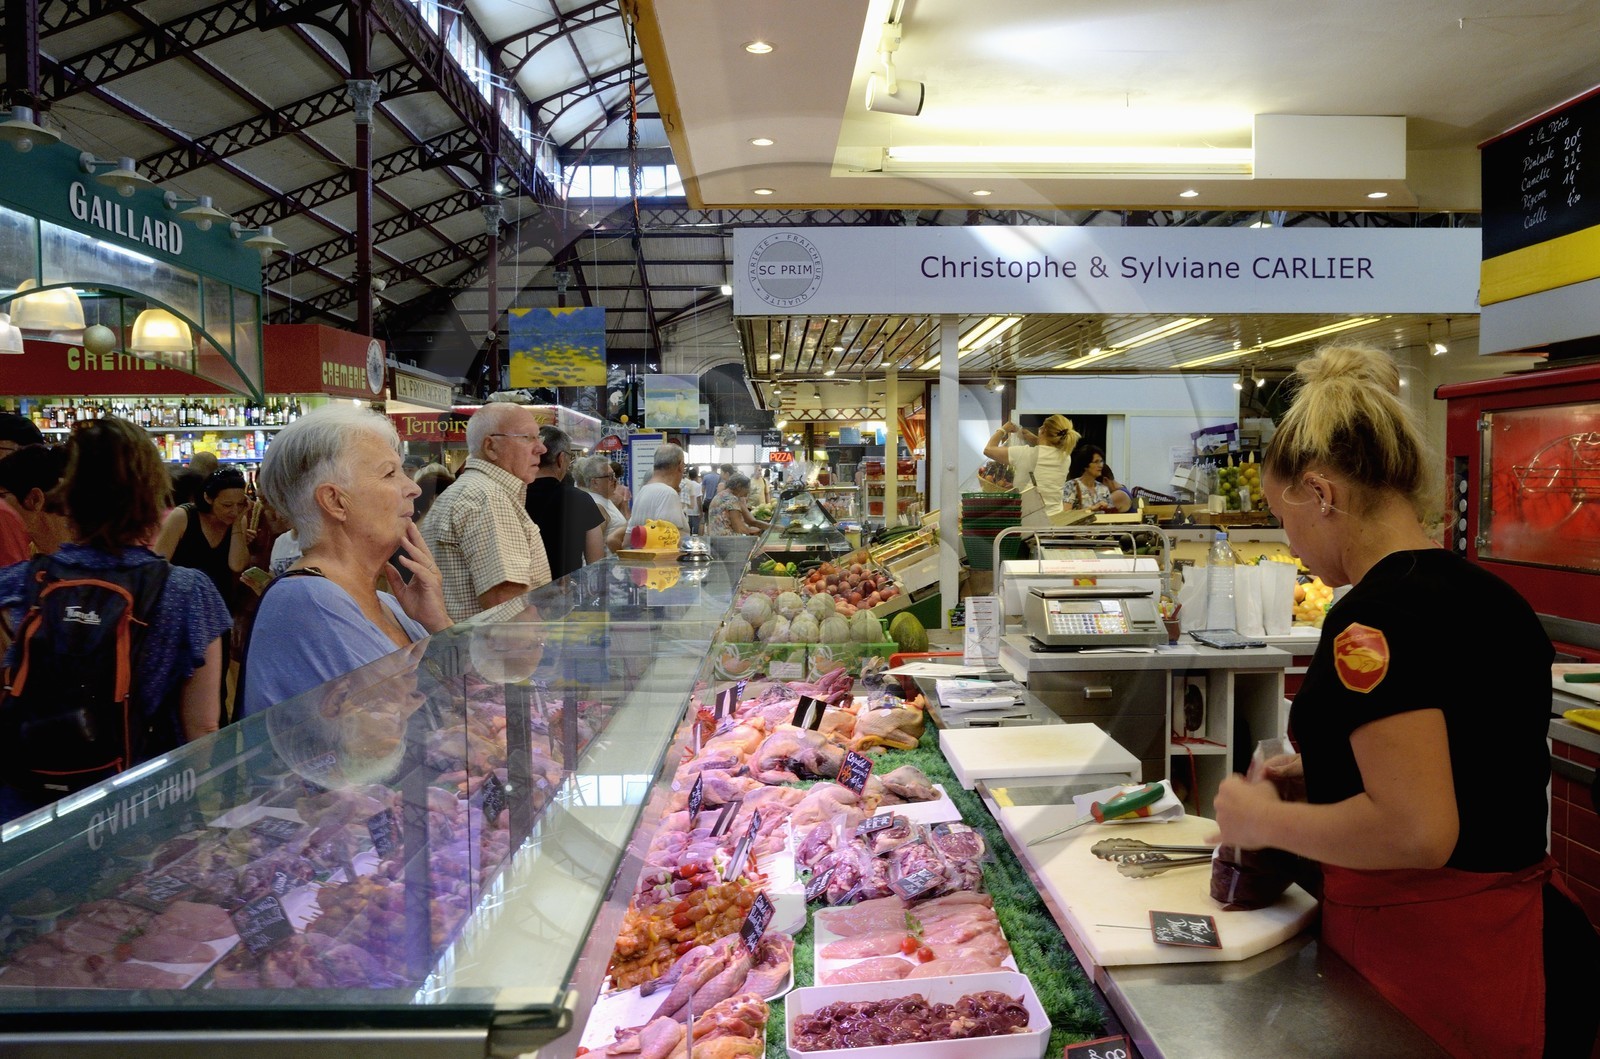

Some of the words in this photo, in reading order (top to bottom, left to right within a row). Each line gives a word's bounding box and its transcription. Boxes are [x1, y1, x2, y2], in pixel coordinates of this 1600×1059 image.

[1523, 146, 1554, 173] Pintade
[1521, 167, 1551, 192] Canette
[1521, 189, 1548, 211] Pigeon
[69, 181, 183, 255] GAILLARD
[1524, 206, 1547, 229] Caille
[750, 239, 770, 282] VARIETE
[759, 265, 776, 275] SC
[781, 265, 812, 275] PRIM
[787, 234, 821, 281] FRAICHEUR
[920, 256, 1077, 283] Christophe
[1090, 256, 1109, 279] &
[1121, 256, 1240, 284] Sylviane
[1252, 257, 1375, 279] CARLIER
[764, 293, 808, 306] QUALITE
[322, 361, 366, 390] CREMERIE
[402, 416, 468, 436] Terroirs
[770, 452, 793, 462] PIZZA
